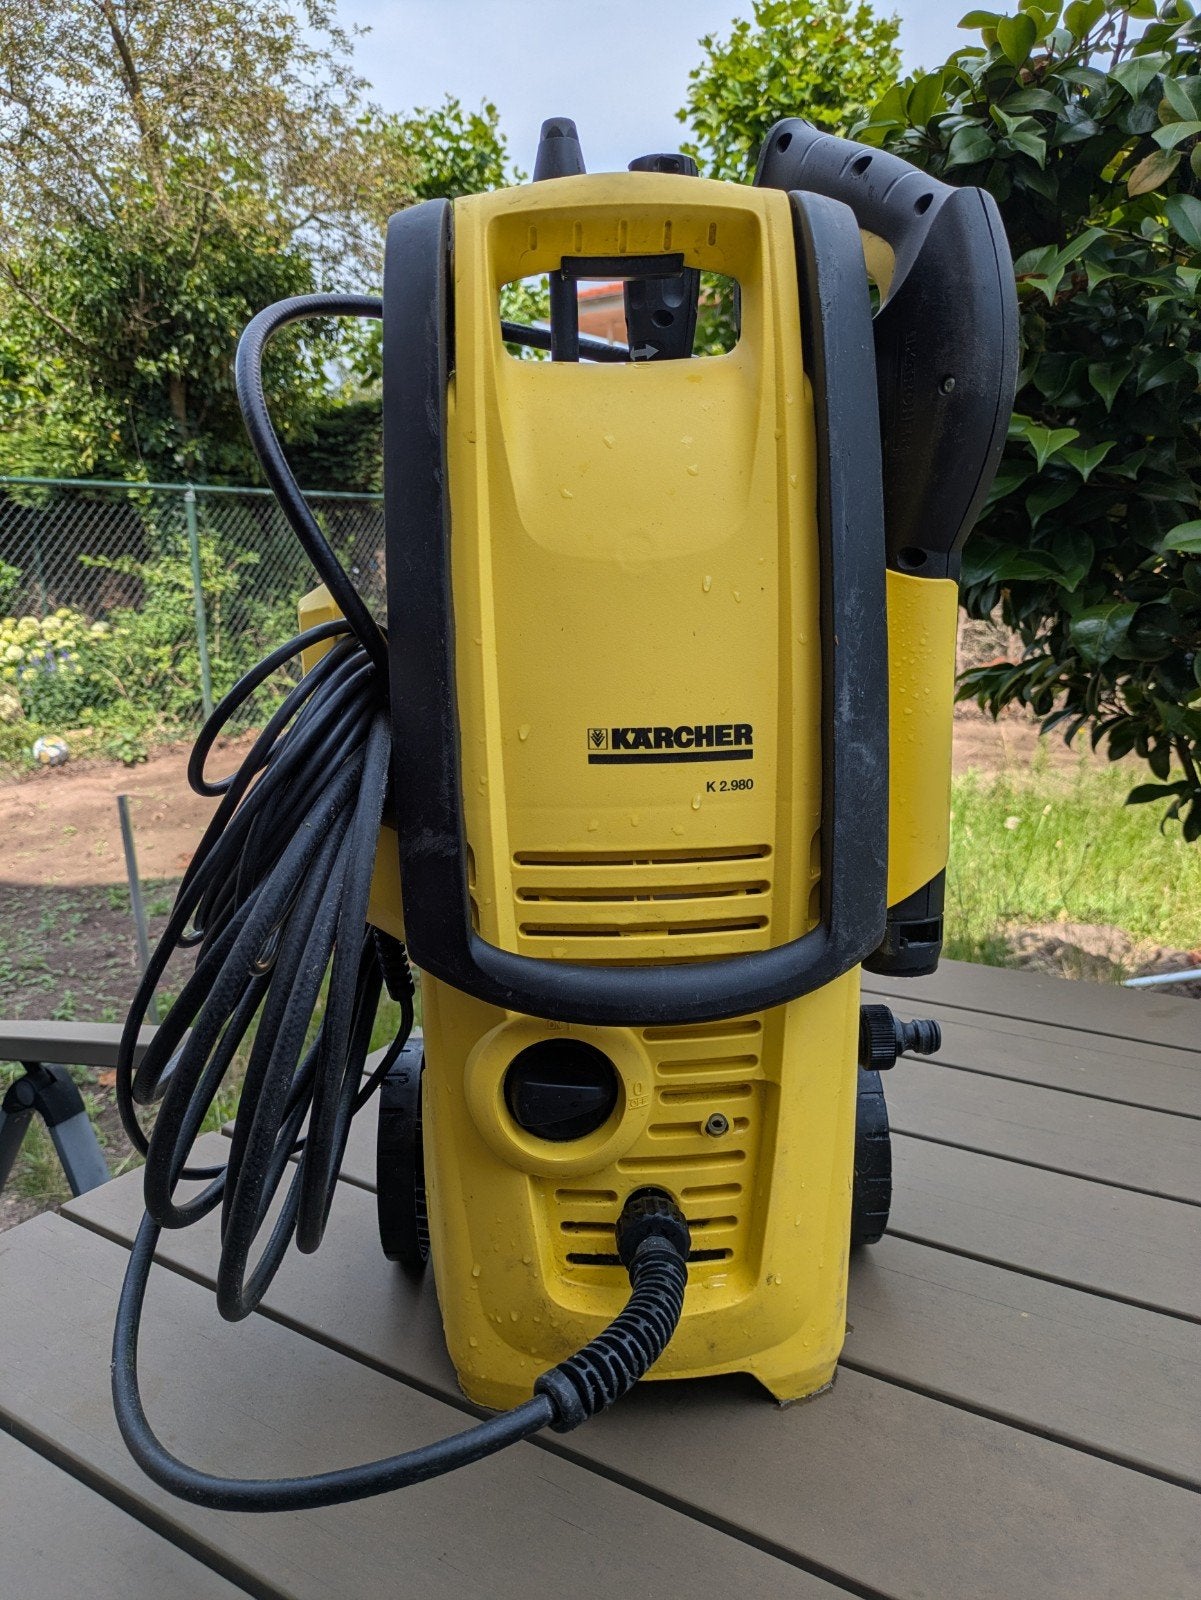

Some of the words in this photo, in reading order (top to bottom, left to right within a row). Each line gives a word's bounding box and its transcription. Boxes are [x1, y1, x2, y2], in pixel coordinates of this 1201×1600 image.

[611, 724, 753, 749] KÄRCHER
[706, 781, 716, 793] K
[719, 778, 754, 792] 2.980
